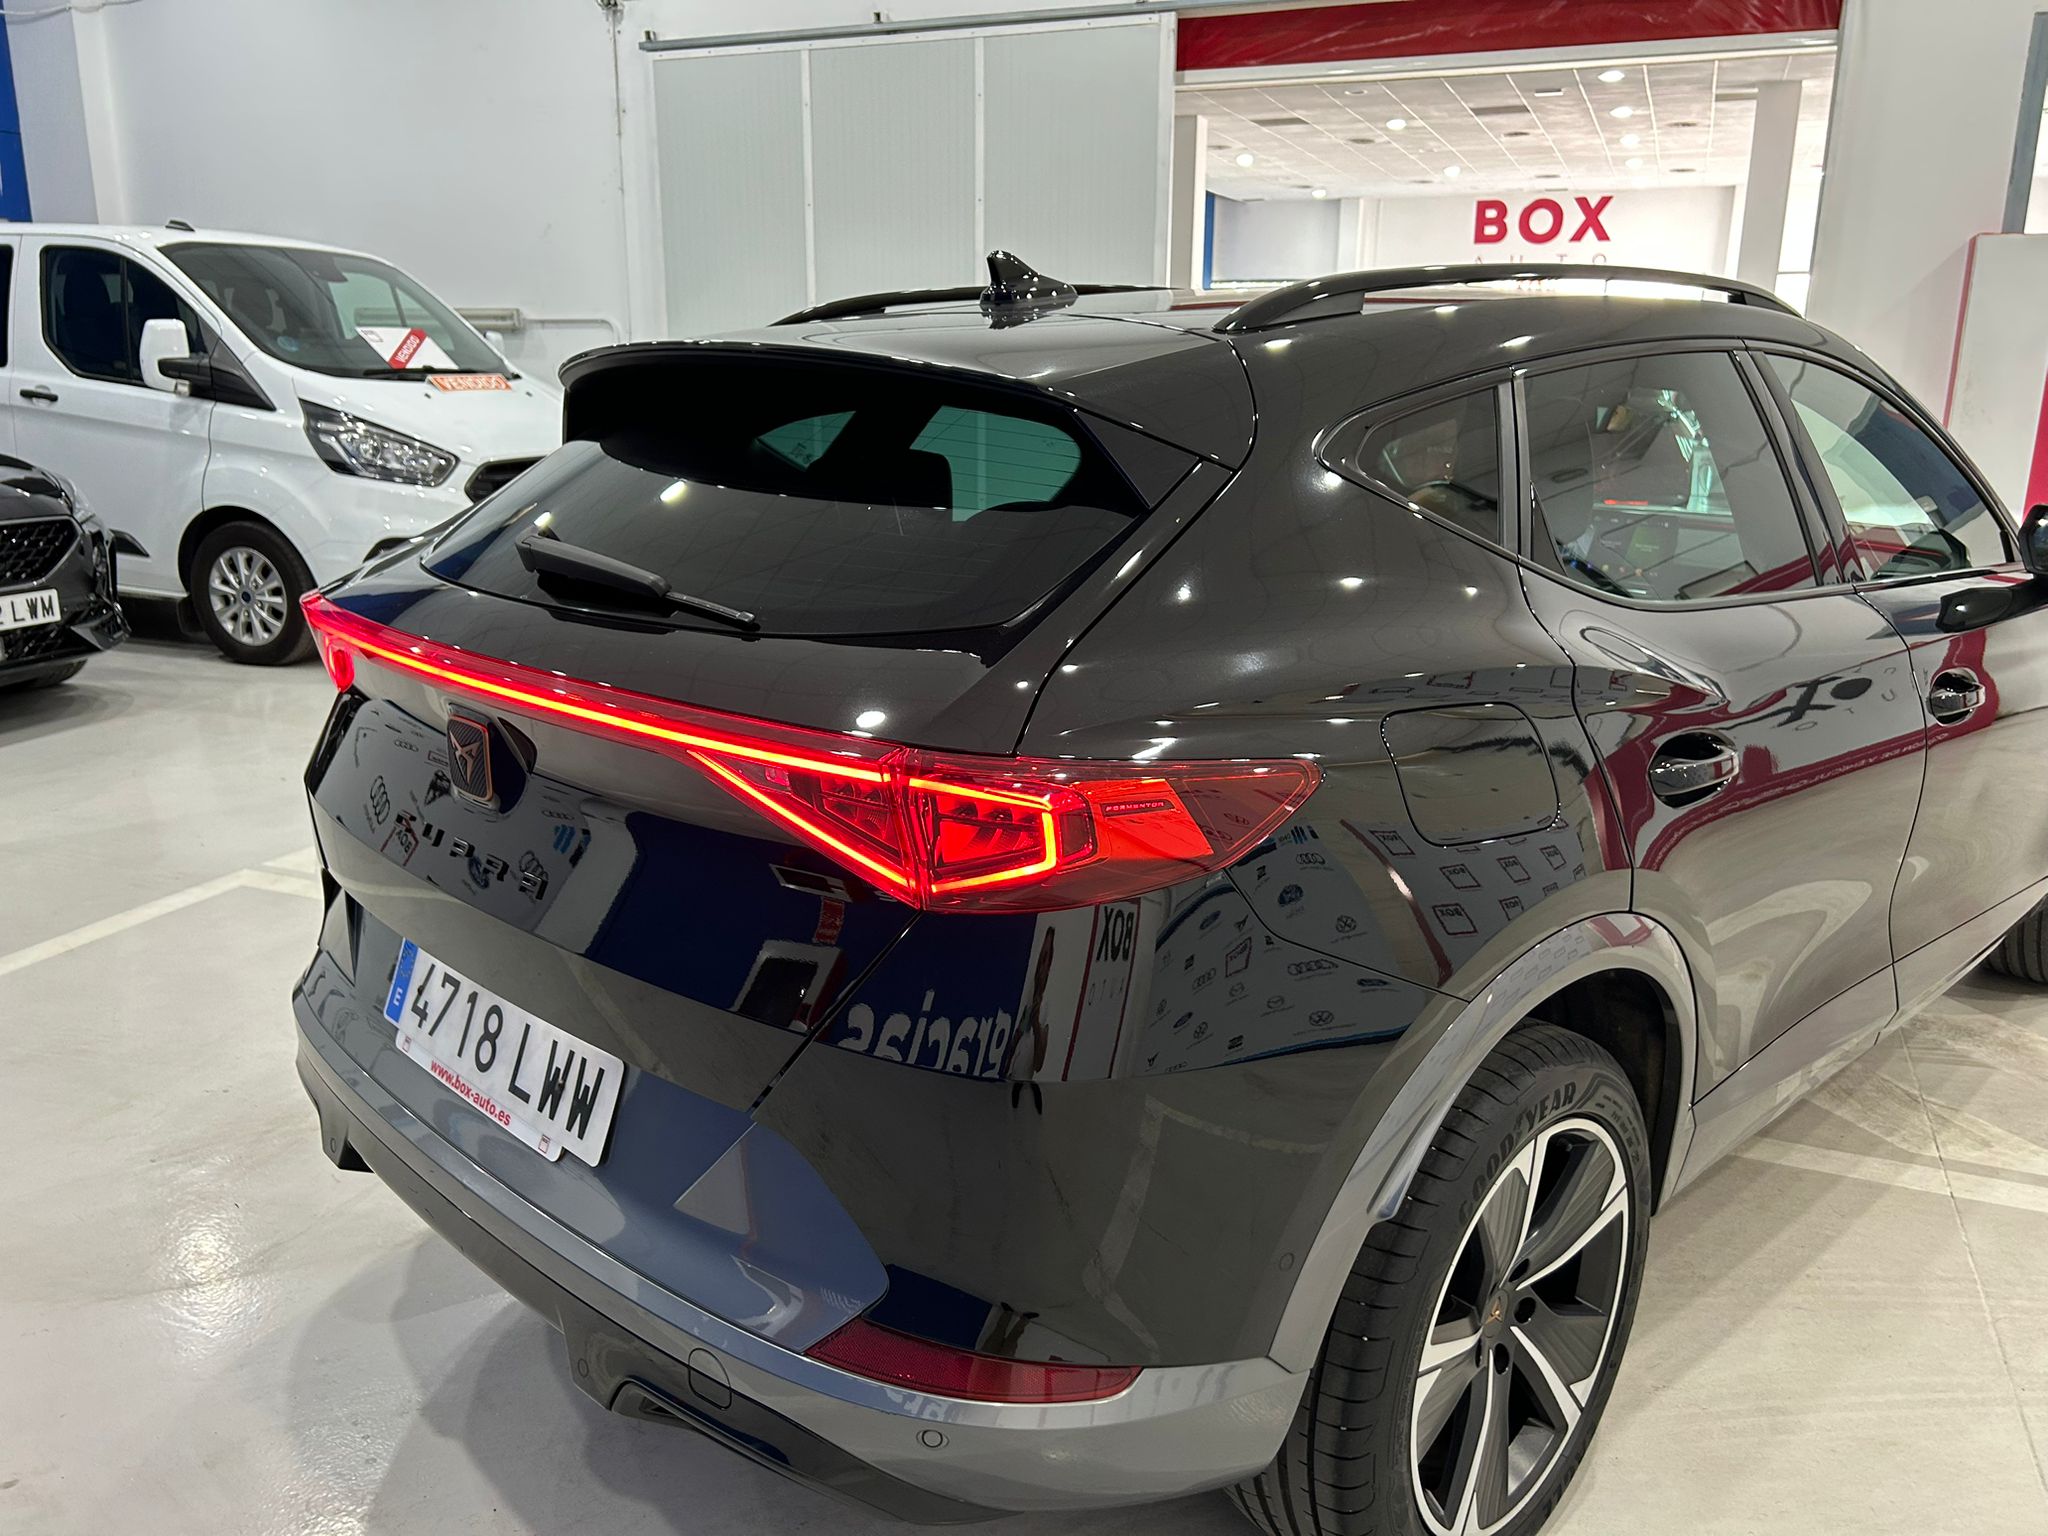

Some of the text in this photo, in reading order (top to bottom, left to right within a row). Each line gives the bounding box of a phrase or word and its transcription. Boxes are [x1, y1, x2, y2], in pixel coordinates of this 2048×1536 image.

[1474, 195, 1613, 244] BOX
[394, 335, 420, 363] VENDIDO
[438, 375, 509, 391] VENDIDO
[11, 594, 55, 622] LWM
[1105, 801, 1165, 812] FORMENTOR
[395, 812, 549, 900] CUPRA
[393, 987, 403, 1006] E
[411, 963, 606, 1141] 4718 LWW
[430, 1060, 512, 1127] www.box-auto.es
